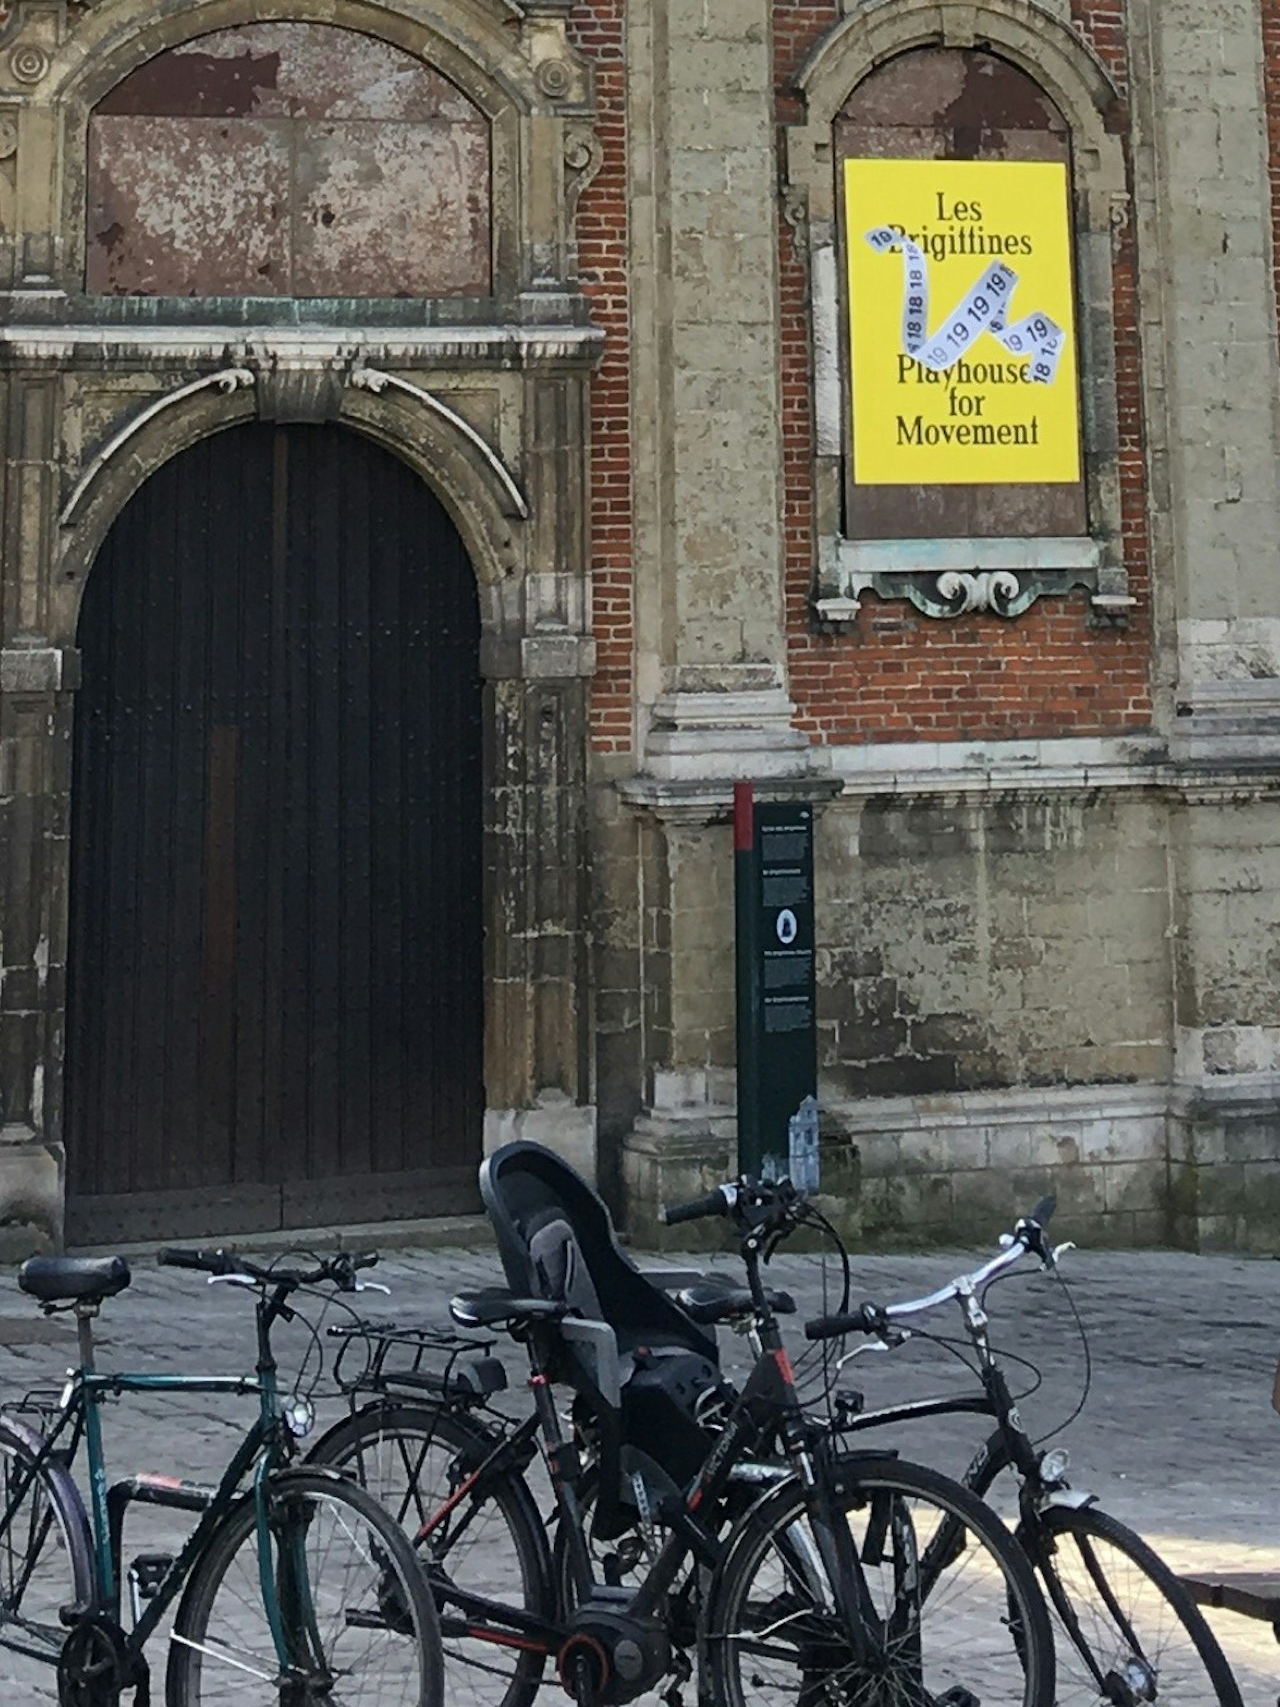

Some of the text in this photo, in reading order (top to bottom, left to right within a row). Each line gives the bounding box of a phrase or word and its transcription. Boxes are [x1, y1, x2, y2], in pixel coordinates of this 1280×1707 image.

[936, 192, 982, 221] Les
[908, 269, 923, 289] 18
[908, 295, 923, 315] 18
[927, 346, 949, 366] 19
[946, 322, 970, 348] 19
[967, 295, 990, 322] 19
[986, 272, 1007, 297] 19
[1003, 333, 1023, 352] 19
[1026, 318, 1048, 343] 19
[897, 354, 1032, 392] Playhouse
[1033, 362, 1052, 385] 18
[949, 387, 986, 416] for
[895, 415, 1039, 445] Movement
